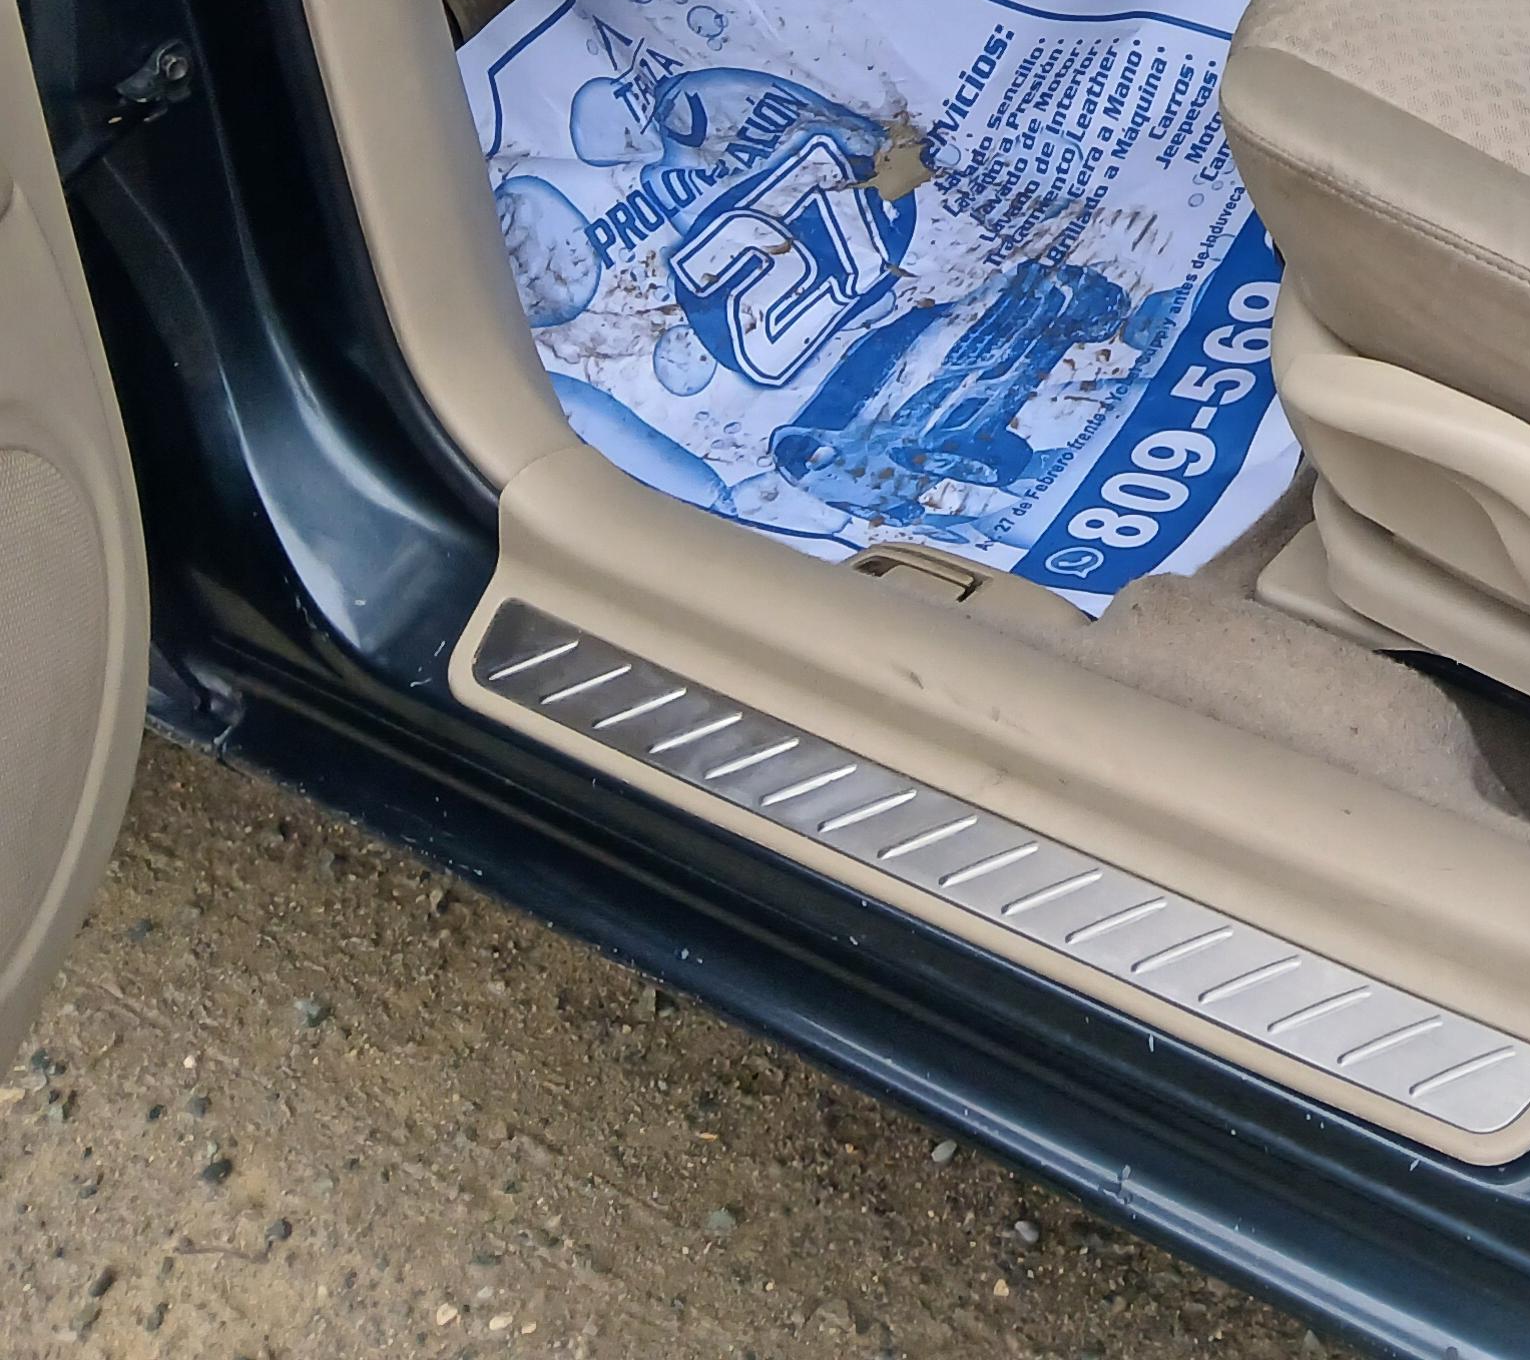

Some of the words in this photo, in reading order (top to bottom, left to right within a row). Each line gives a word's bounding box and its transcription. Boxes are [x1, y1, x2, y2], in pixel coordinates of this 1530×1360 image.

[918, 21, 1016, 167] ervicios:
[987, 43, 1044, 130] Sencillo
[1005, 46, 1062, 129] Presión
[1018, 115, 1043, 149] de
[1034, 44, 1081, 112] Motor
[1045, 48, 1097, 135] Interior
[1065, 45, 1120, 141] Leather
[1102, 50, 1143, 119] Mano
[1102, 162, 1118, 179] a
[1111, 56, 1167, 159] Máquina
[1149, 63, 1196, 141] Carros
[1155, 70, 1219, 169] Jeepetas
[998, 135, 1014, 153] a
[1033, 141, 1059, 174] de
[1066, 146, 1104, 198] Cera
[1096, 124, 1114, 142] a
[669, 132, 892, 385] 27
[992, 514, 1016, 534] 27
[1010, 498, 1033, 518] de
[1023, 448, 1077, 500] Febrero
[1064, 410, 1107, 453] frente
[1166, 269, 1198, 314] antes
[1188, 248, 1210, 270] de
